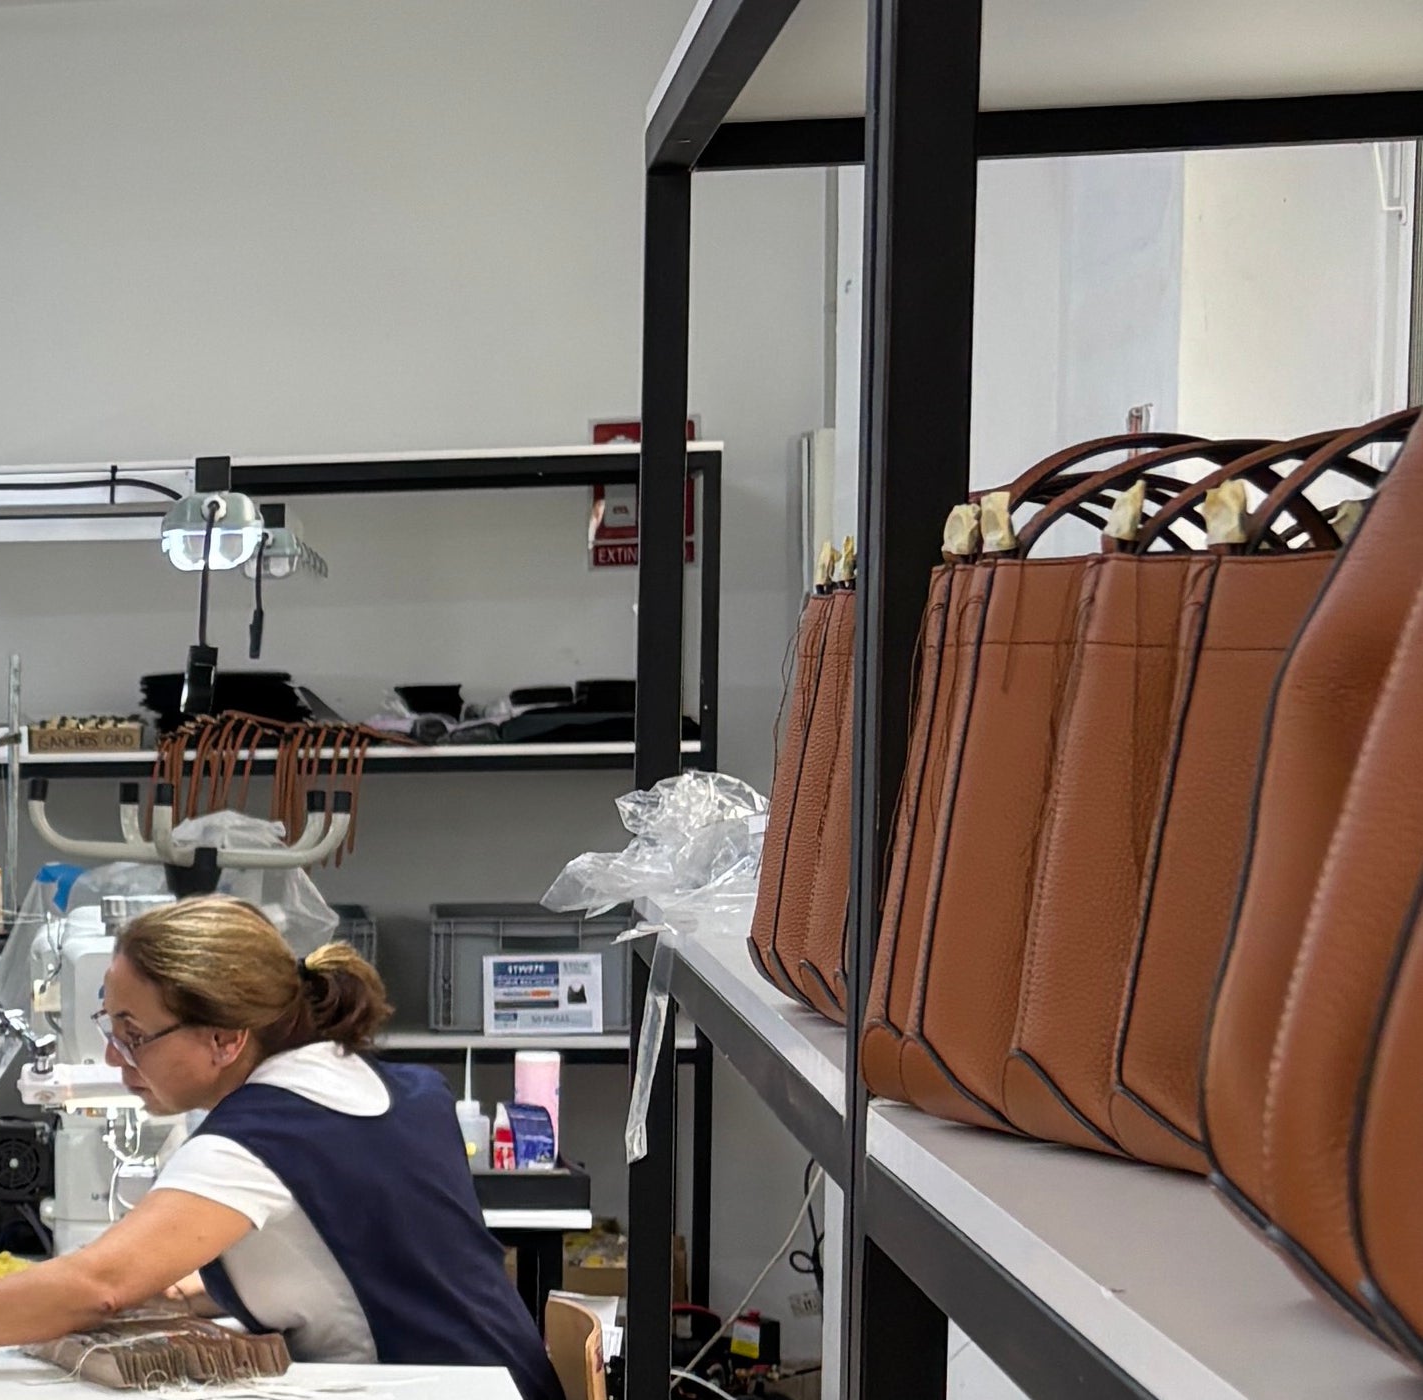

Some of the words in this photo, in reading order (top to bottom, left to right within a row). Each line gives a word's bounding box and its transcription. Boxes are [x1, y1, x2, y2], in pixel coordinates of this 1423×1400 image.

[597, 547, 637, 563] EXTIN
[37, 733, 98, 748] GANCHOS
[105, 733, 133, 747] ORO
